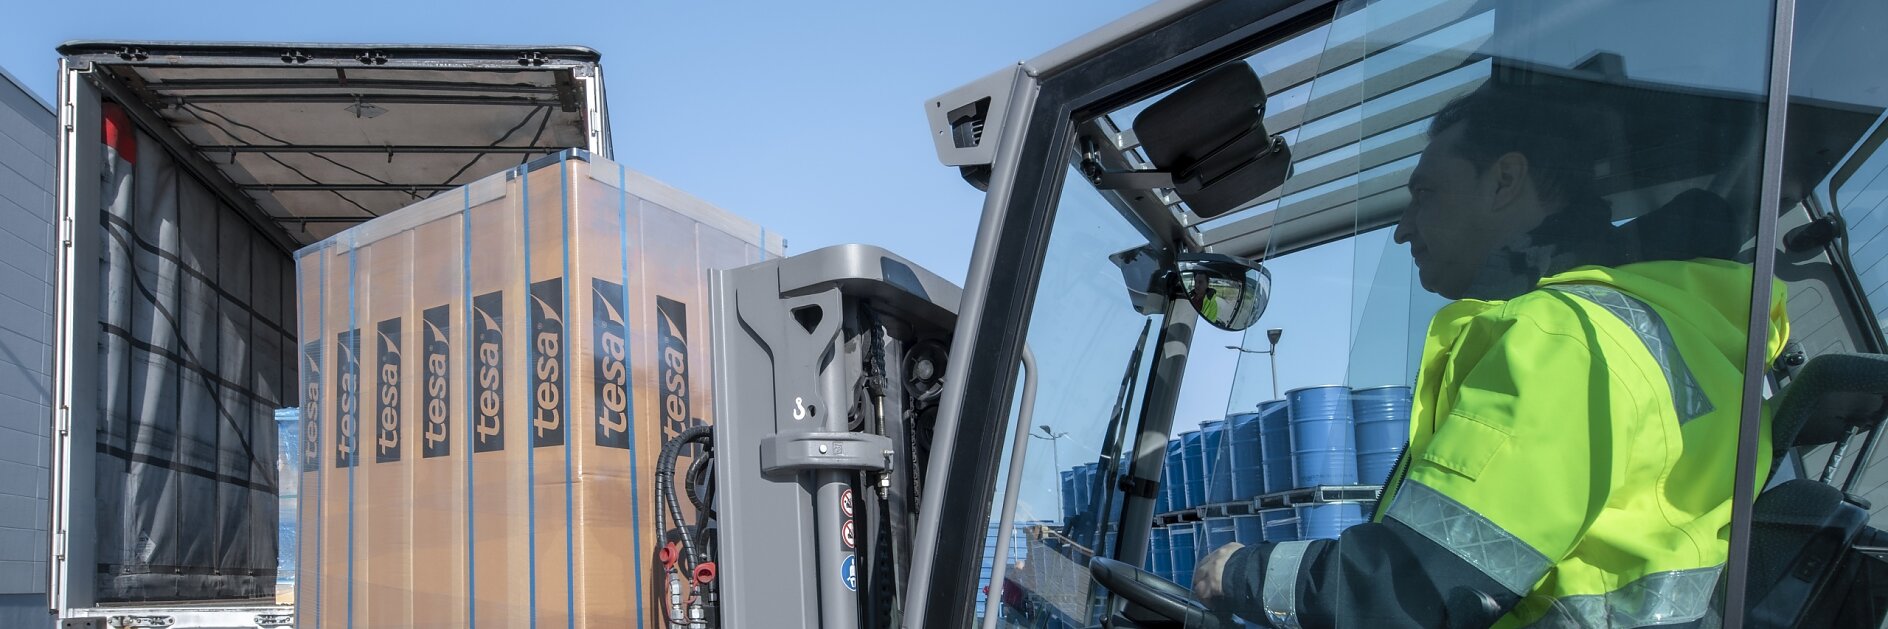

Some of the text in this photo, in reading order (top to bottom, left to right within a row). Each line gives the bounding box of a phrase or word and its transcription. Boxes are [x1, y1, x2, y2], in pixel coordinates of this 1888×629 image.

[305, 382, 319, 464] tesa
[338, 372, 357, 461] tesa
[378, 363, 398, 455] tesa
[425, 353, 447, 449] tesa
[476, 342, 500, 444] tesa
[533, 331, 560, 438] tesa
[599, 331, 628, 438] tesa
[663, 346, 687, 440] tesa
